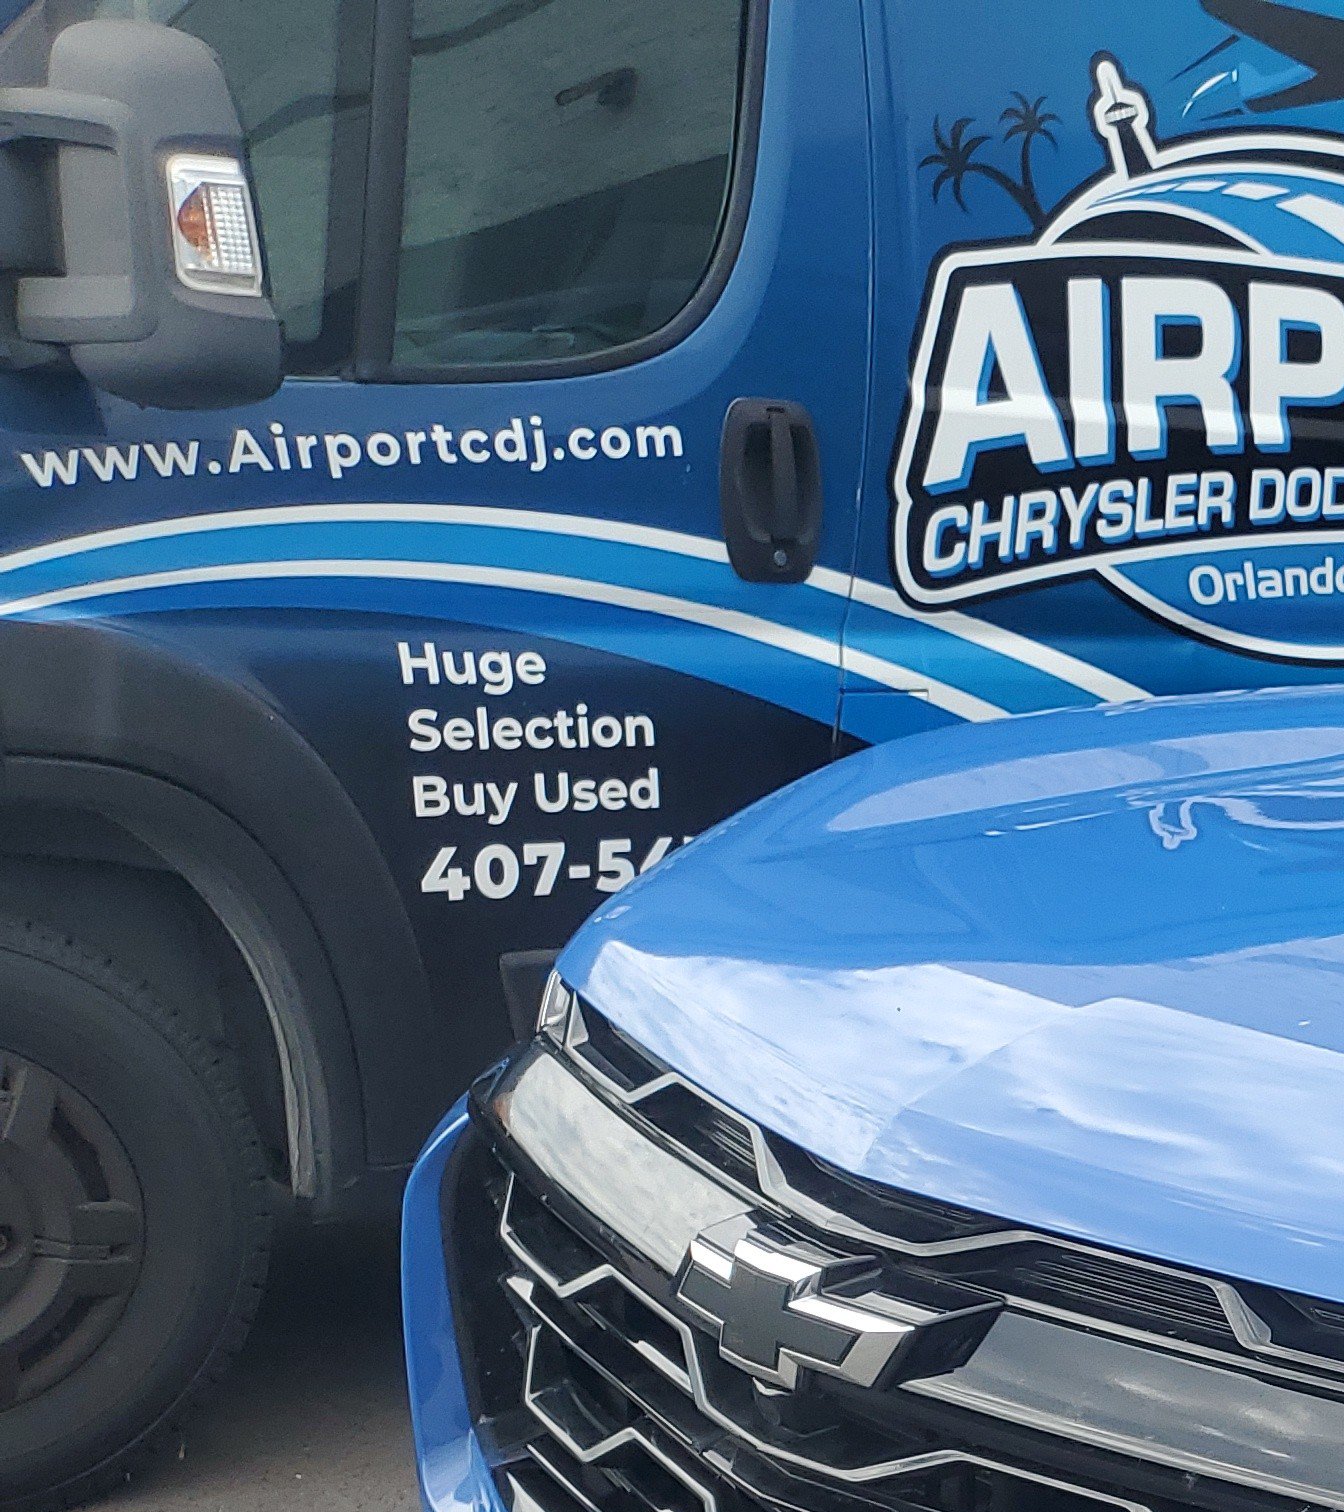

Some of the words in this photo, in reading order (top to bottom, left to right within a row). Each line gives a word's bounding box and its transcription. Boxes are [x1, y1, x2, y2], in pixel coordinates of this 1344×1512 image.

[20, 415, 685, 489] www.Airportcdj.com
[922, 470, 1236, 577] CHRYSLER
[397, 640, 548, 696] Huge
[408, 703, 656, 753] Selection
[412, 774, 519, 826] Buy
[533, 767, 661, 813] Used
[420, 835, 697, 902] 407-5
